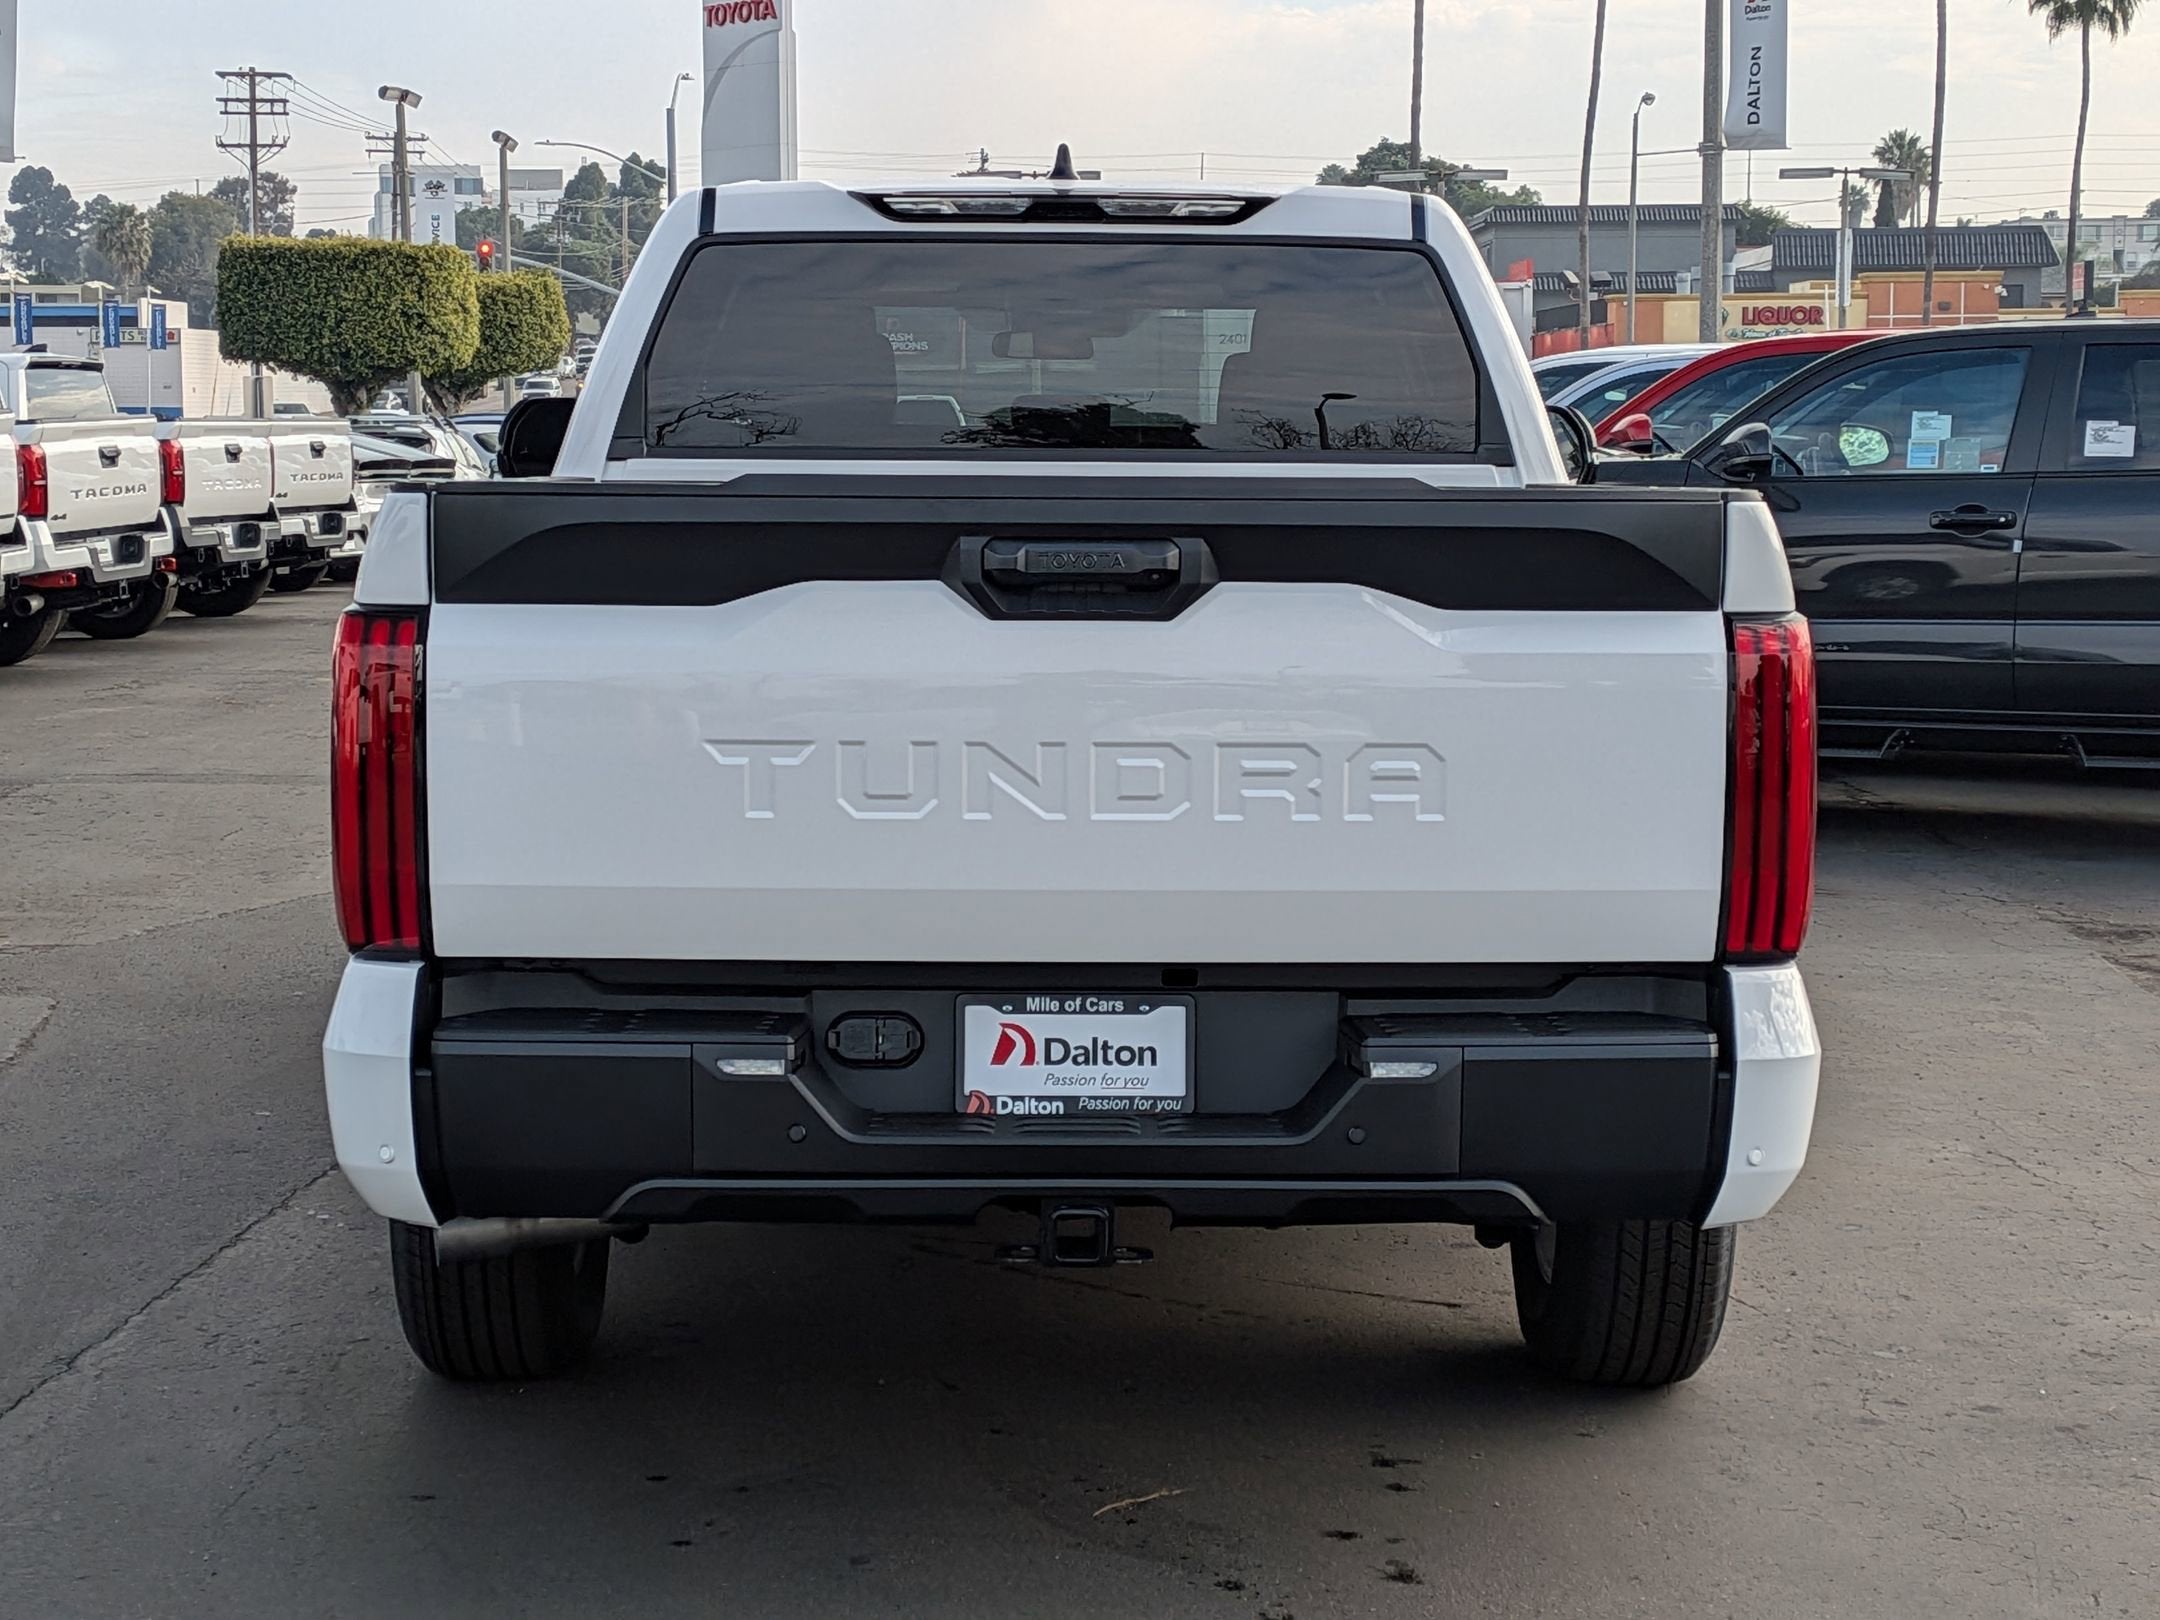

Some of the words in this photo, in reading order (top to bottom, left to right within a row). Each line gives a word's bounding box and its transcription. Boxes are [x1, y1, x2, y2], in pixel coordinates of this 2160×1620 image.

[703, 0, 778, 28] TOYOTA
[1746, 46, 1762, 125] DALTON
[1741, 306, 1825, 326] LIQUOR
[1218, 333, 1248, 345] 2401
[290, 472, 344, 483] TACOMA
[70, 483, 147, 499] TACOMA
[1038, 552, 1126, 570] TOYOTA
[701, 738, 1448, 823] TUNDRA
[1026, 997, 1060, 1012] Mile
[1064, 997, 1081, 1012] of
[1086, 997, 1124, 1012] Cars
[1044, 1036, 1157, 1067] Dalton
[1044, 1073, 1096, 1087] Passion
[1100, 1073, 1120, 1087] for
[1123, 1076, 1149, 1088] you
[996, 1097, 1064, 1115] Dalton
[1078, 1097, 1132, 1111] Passion
[1133, 1097, 1152, 1111] for
[1155, 1099, 1182, 1113] you
